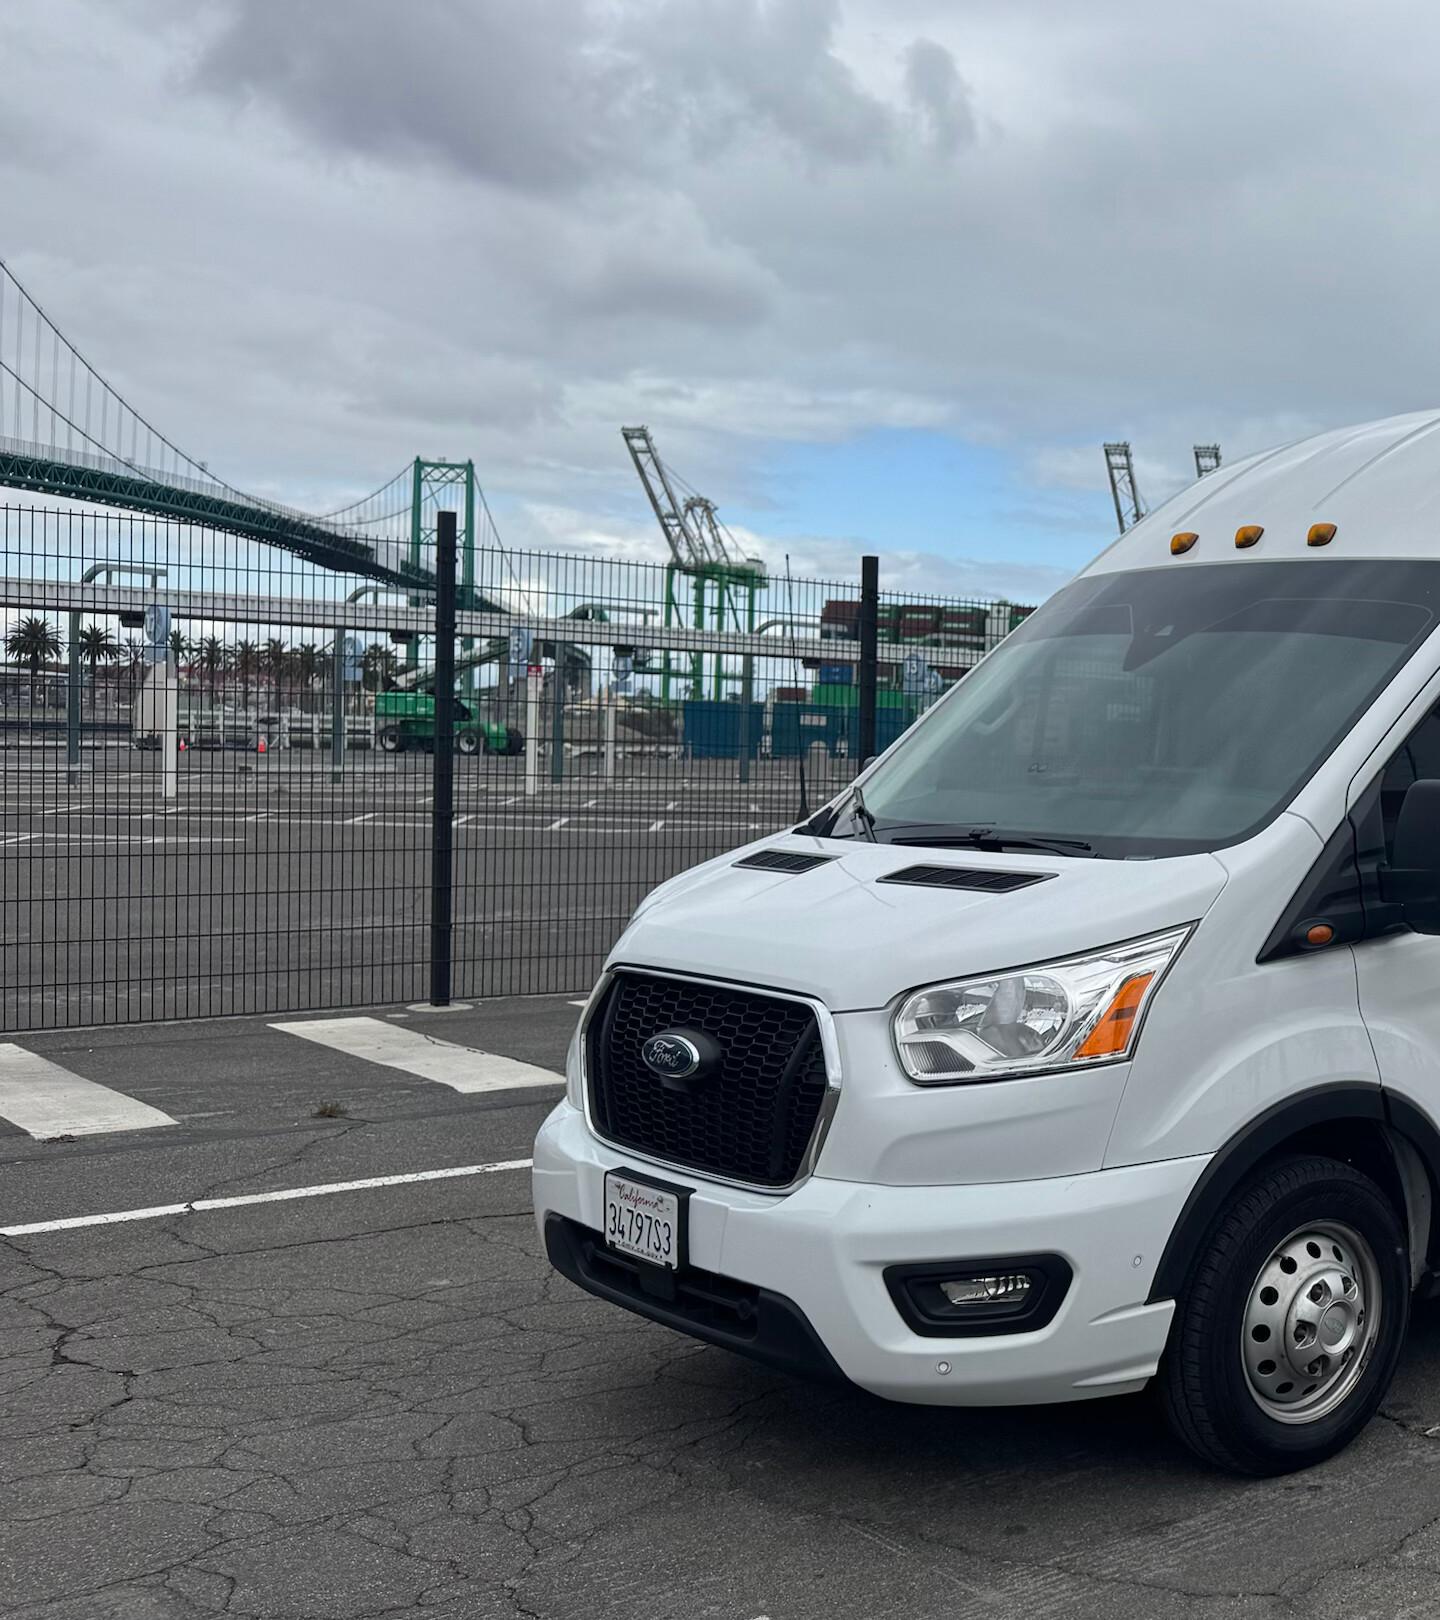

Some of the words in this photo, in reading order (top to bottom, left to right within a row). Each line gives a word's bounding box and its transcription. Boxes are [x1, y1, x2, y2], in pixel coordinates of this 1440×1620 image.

[649, 1040, 681, 1067] Ford
[617, 1184, 663, 1212] California
[609, 1203, 671, 1255] 34797S3
